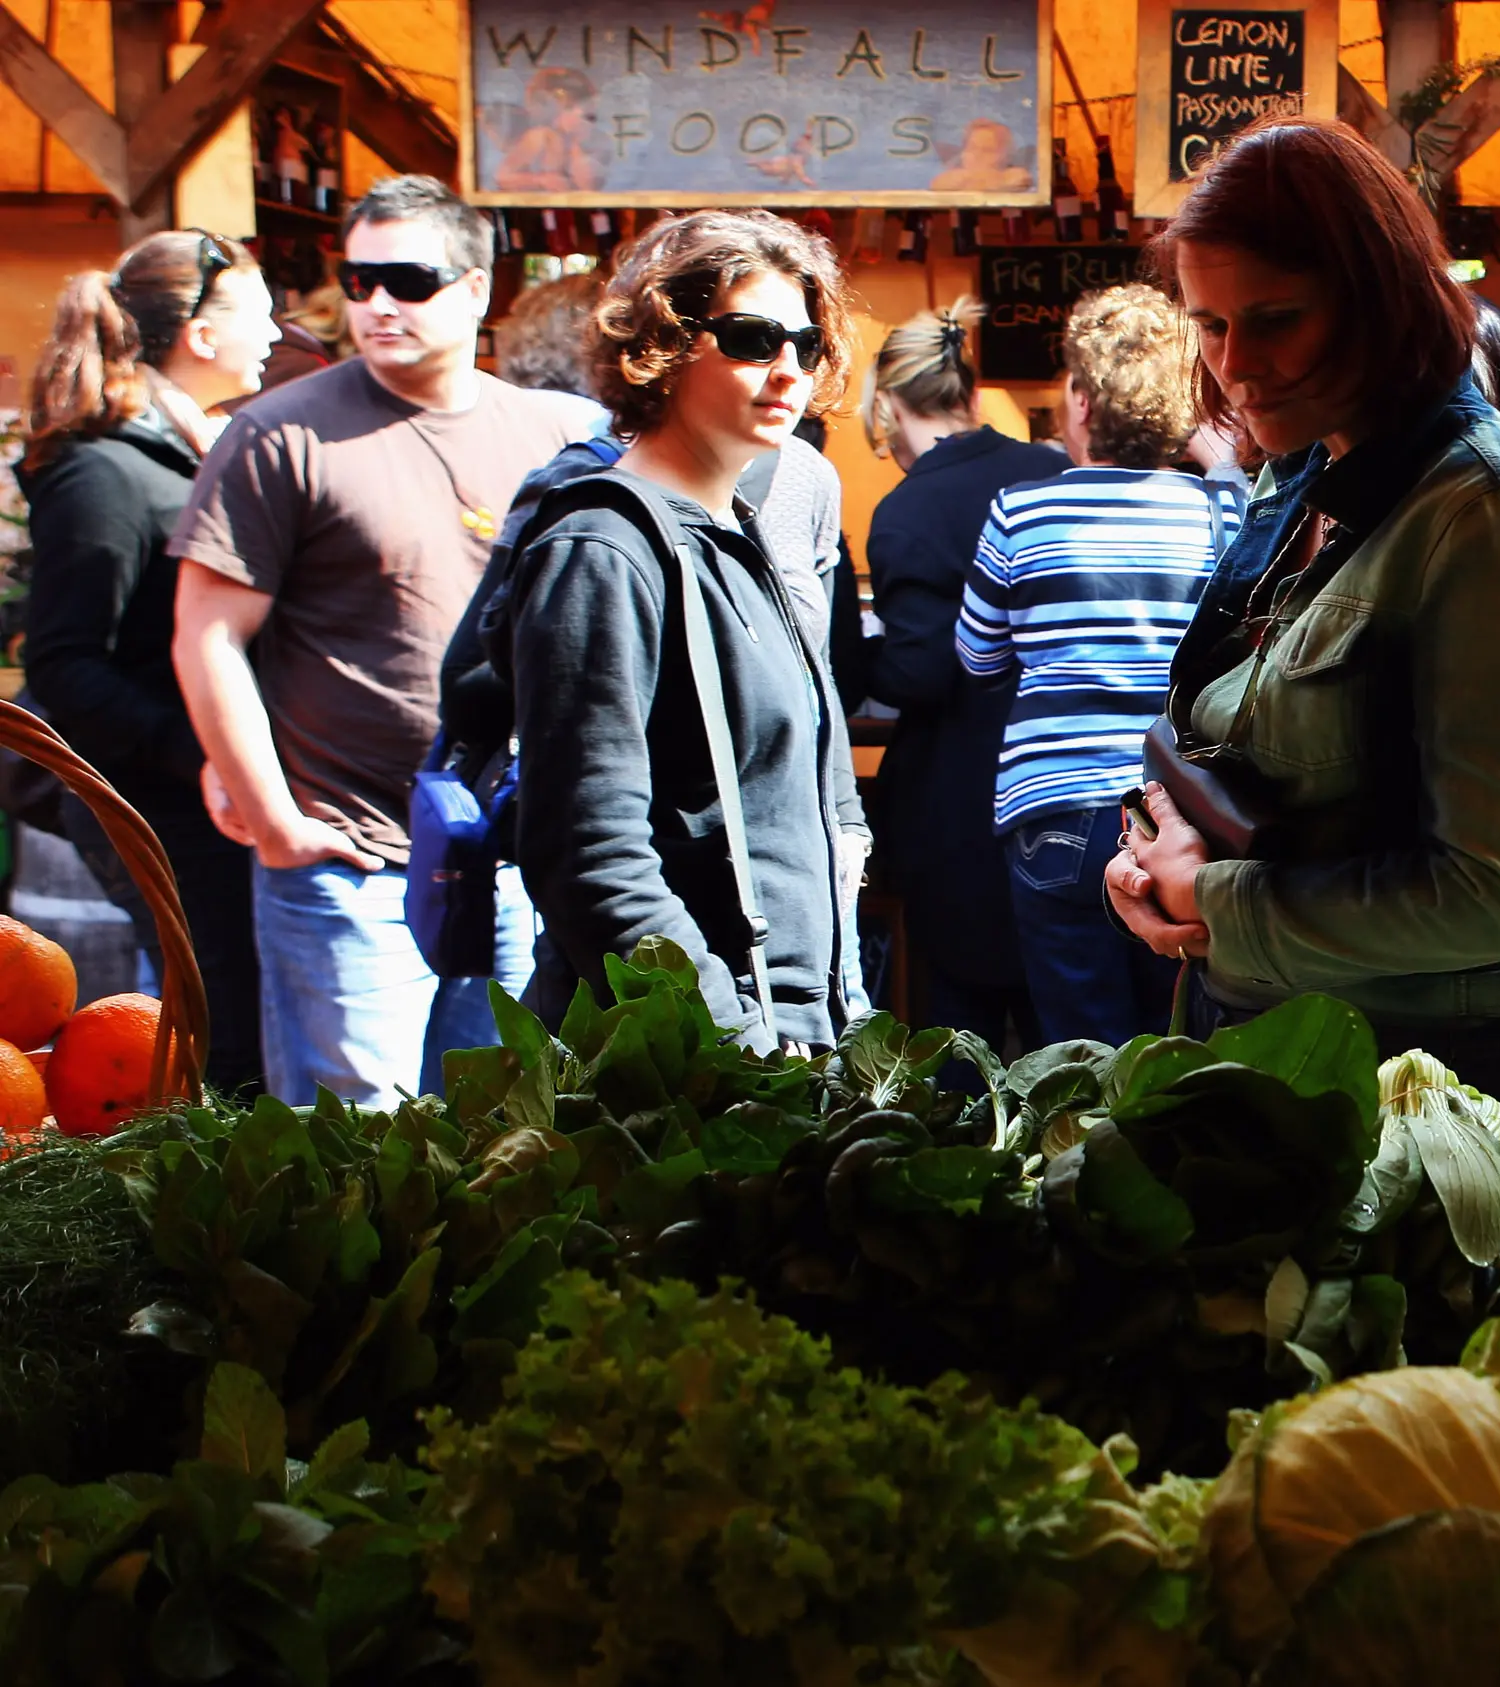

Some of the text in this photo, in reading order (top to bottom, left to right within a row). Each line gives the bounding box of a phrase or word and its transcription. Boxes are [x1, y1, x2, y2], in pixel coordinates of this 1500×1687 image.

[486, 25, 1024, 80] WINDFALL
[1175, 17, 1296, 56] LEMON,
[1185, 52, 1284, 89] LIME,
[612, 113, 933, 157] FOODS
[991, 251, 1128, 294] FIG RELI
[991, 303, 1073, 327] CRAN
